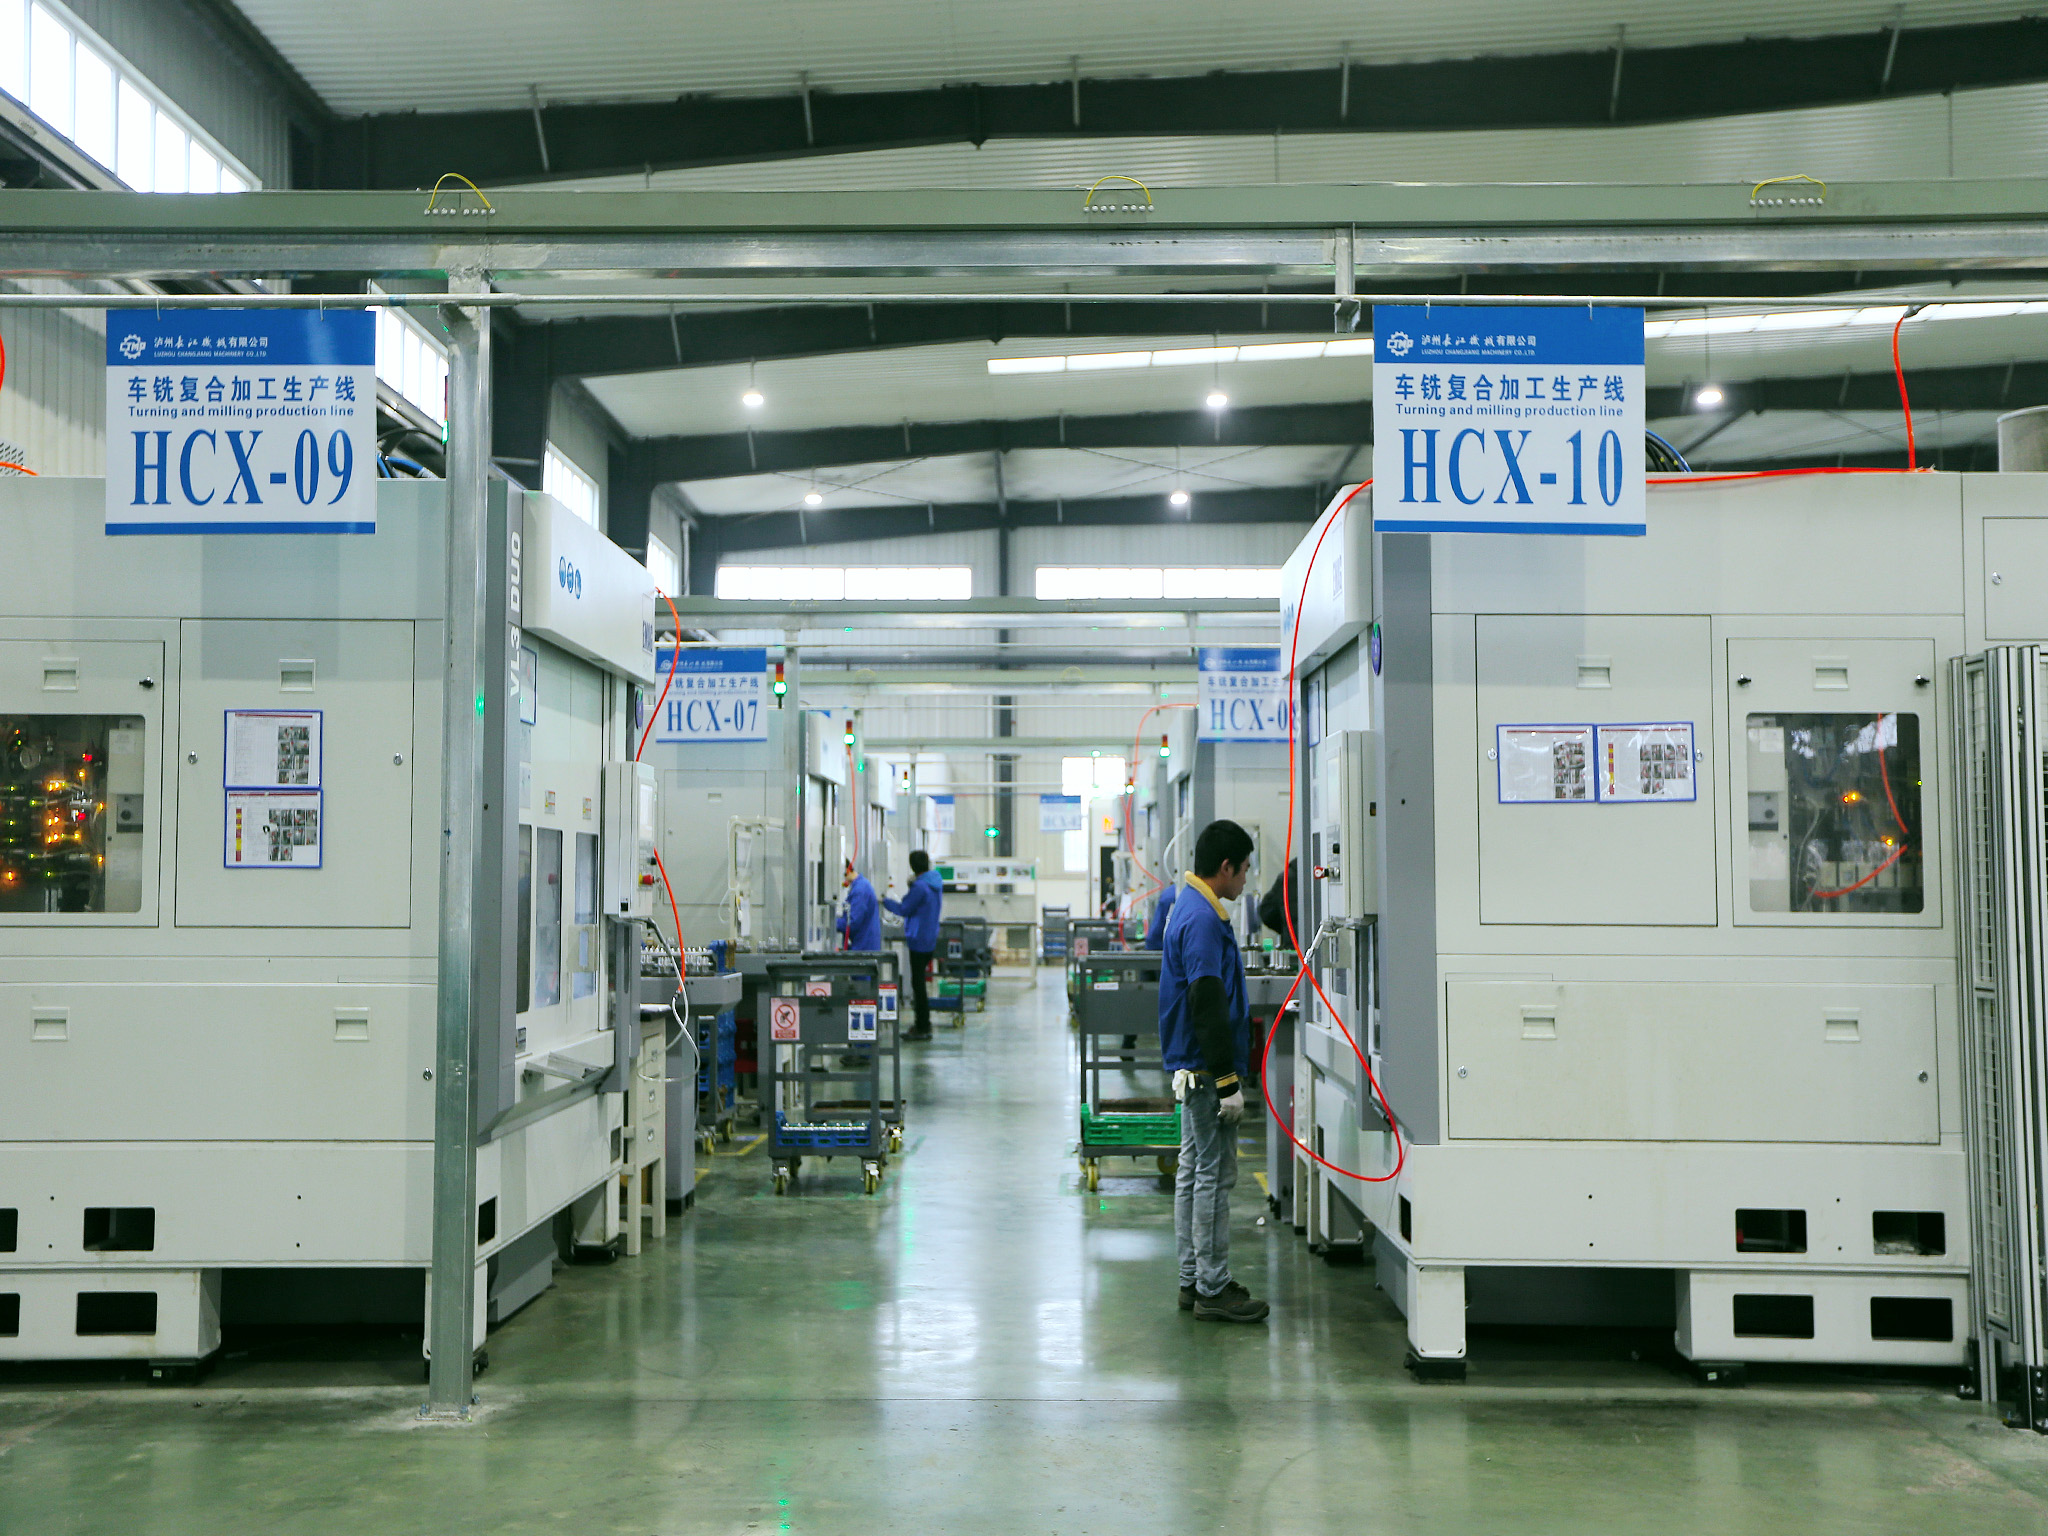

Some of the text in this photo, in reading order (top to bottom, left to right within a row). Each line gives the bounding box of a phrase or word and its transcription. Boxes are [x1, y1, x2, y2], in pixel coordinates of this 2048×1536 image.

[128, 375, 356, 402] 车铣复合加工生产线
[1395, 373, 1625, 402] 车铣复合加工生产线
[129, 405, 354, 419] Turning and milling production line
[1396, 403, 1623, 418] Turning and milling production line
[130, 428, 354, 506] HCX-09
[1399, 428, 1623, 506] HCX-10
[509, 531, 520, 697] VL3 DUO
[667, 699, 758, 732] HCX-07
